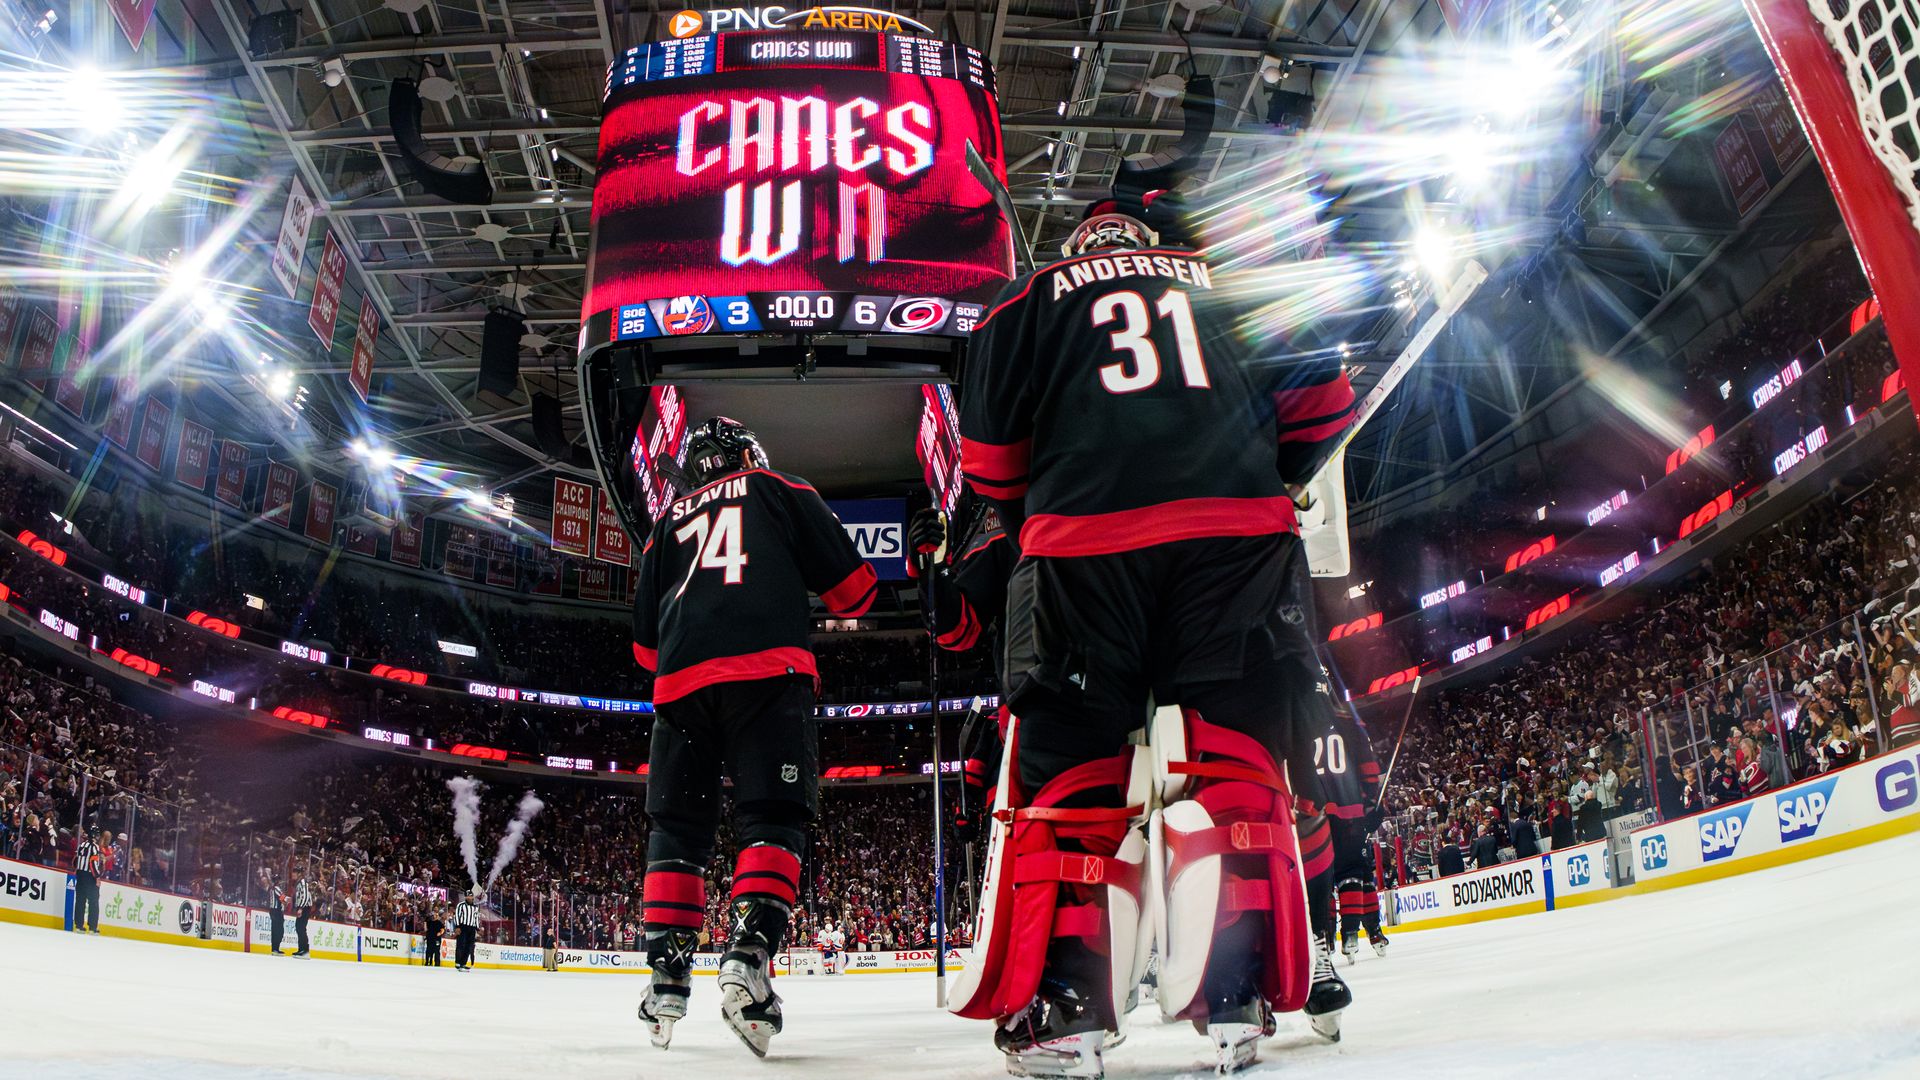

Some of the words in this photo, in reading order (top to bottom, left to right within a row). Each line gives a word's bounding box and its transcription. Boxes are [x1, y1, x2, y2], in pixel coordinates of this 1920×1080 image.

[708, 6, 786, 32] PNC
[804, 6, 903, 32] ARENA
[660, 39, 681, 47] TIME
[893, 35, 915, 44] TIME
[751, 41, 810, 60] CANES
[815, 41, 852, 59] WIN
[676, 94, 934, 177] CANES
[1053, 256, 1213, 302] ANDERSEN
[622, 307, 646, 319] SOG
[727, 301, 749, 325] 3
[854, 301, 876, 325] 6
[956, 306, 980, 318] SOG
[622, 319, 645, 335] 25
[789, 319, 814, 327] THIRD
[1091, 288, 1211, 395] 31
[1752, 374, 1783, 409] CANES
[1774, 439, 1806, 475] CANES
[1804, 424, 1828, 455] WIN
[700, 456, 713, 473] 74
[562, 484, 584, 503] ACC
[672, 477, 747, 521] SLAVIN
[555, 501, 589, 521] CHAMPIONS
[1587, 500, 1611, 528] CANES
[562, 519, 581, 539] 1974
[605, 529, 623, 549] 1973
[675, 505, 749, 600] 74
[1600, 560, 1624, 587] CANES
[1623, 550, 1640, 574] WIN
[102, 573, 130, 598] CANES
[1420, 591, 1448, 609] CANES
[40, 608, 64, 633] CANES
[63, 620, 79, 641] WIN
[281, 640, 309, 660] CANES
[1451, 642, 1476, 663] CANES
[1476, 635, 1492, 654] WIN
[192, 679, 218, 699] CANES
[218, 687, 236, 704] WIN
[469, 682, 497, 698] CANES
[827, 706, 835, 716] 6
[364, 727, 392, 743] CANES
[392, 732, 410, 747] WIN
[547, 755, 574, 769] CANES
[575, 758, 593, 771] WIN
[922, 762, 949, 774] CAES
[1875, 754, 1920, 812] G
[1778, 791, 1826, 835] SAP
[1700, 815, 1744, 855] SAP
[1641, 837, 1667, 869] PPG
[1567, 855, 1590, 886] PPG
[0, 871, 46, 901] PEPSI
[1452, 868, 1535, 907] BODYARMOR
[179, 908, 193, 925] LBC
[364, 935, 399, 951] NUCOR
[500, 951, 543, 963] ticketmaster
[589, 954, 621, 966] UNC
[856, 960, 878, 968] above
[864, 954, 876, 962] sub
[895, 949, 961, 961] HONA
